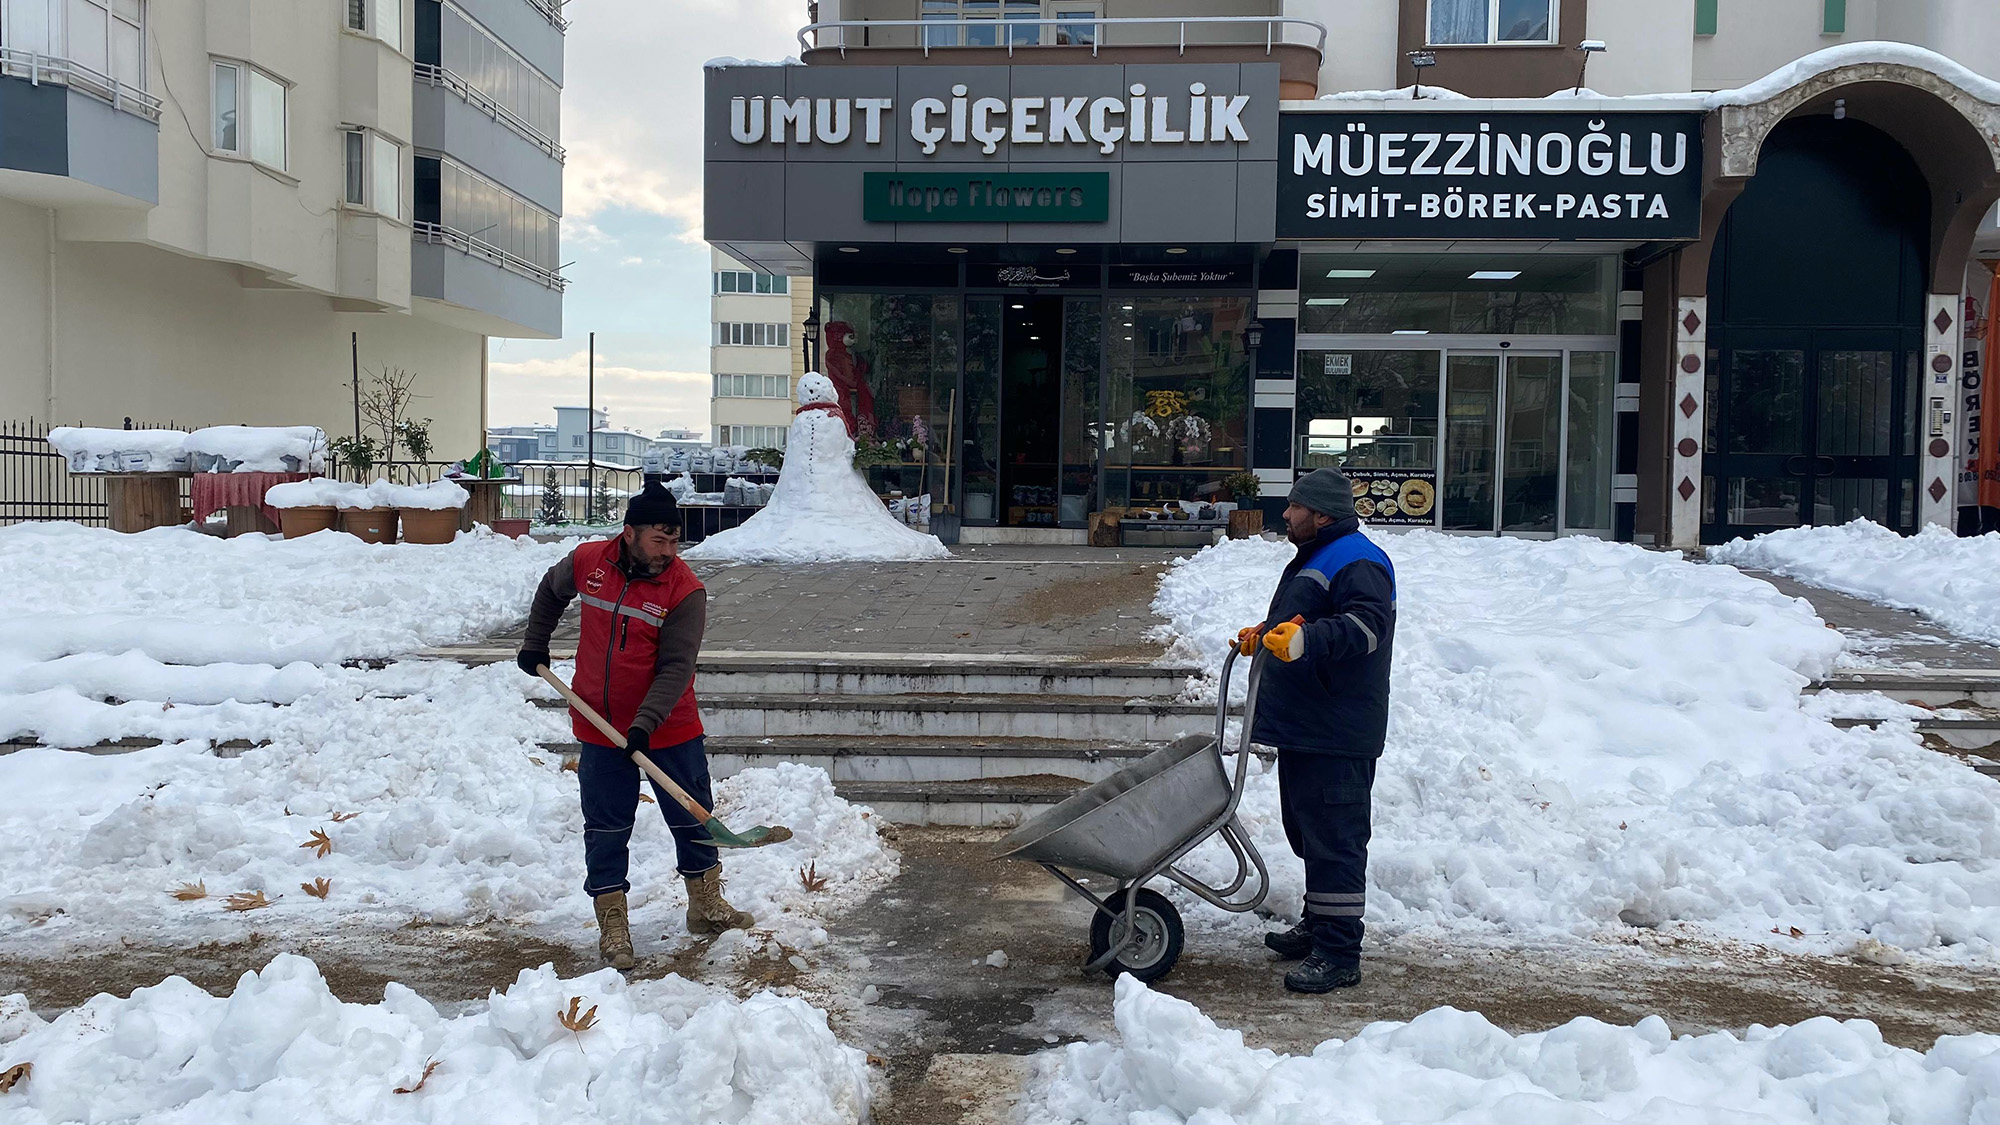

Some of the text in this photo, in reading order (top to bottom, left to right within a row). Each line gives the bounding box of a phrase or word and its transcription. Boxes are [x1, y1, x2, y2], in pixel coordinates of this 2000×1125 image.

[730, 82, 1251, 154] UMUT ÇİÇEKÇİLİK
[1293, 119, 1687, 176] MÜEZZİNOĞLU
[888, 180, 1084, 213] Hope Flowers
[1305, 186, 1670, 219] SİMİT-BÖREK-PASTA
[1161, 272, 1198, 283] Şubemiz
[1326, 356, 1349, 367] EKMEK
